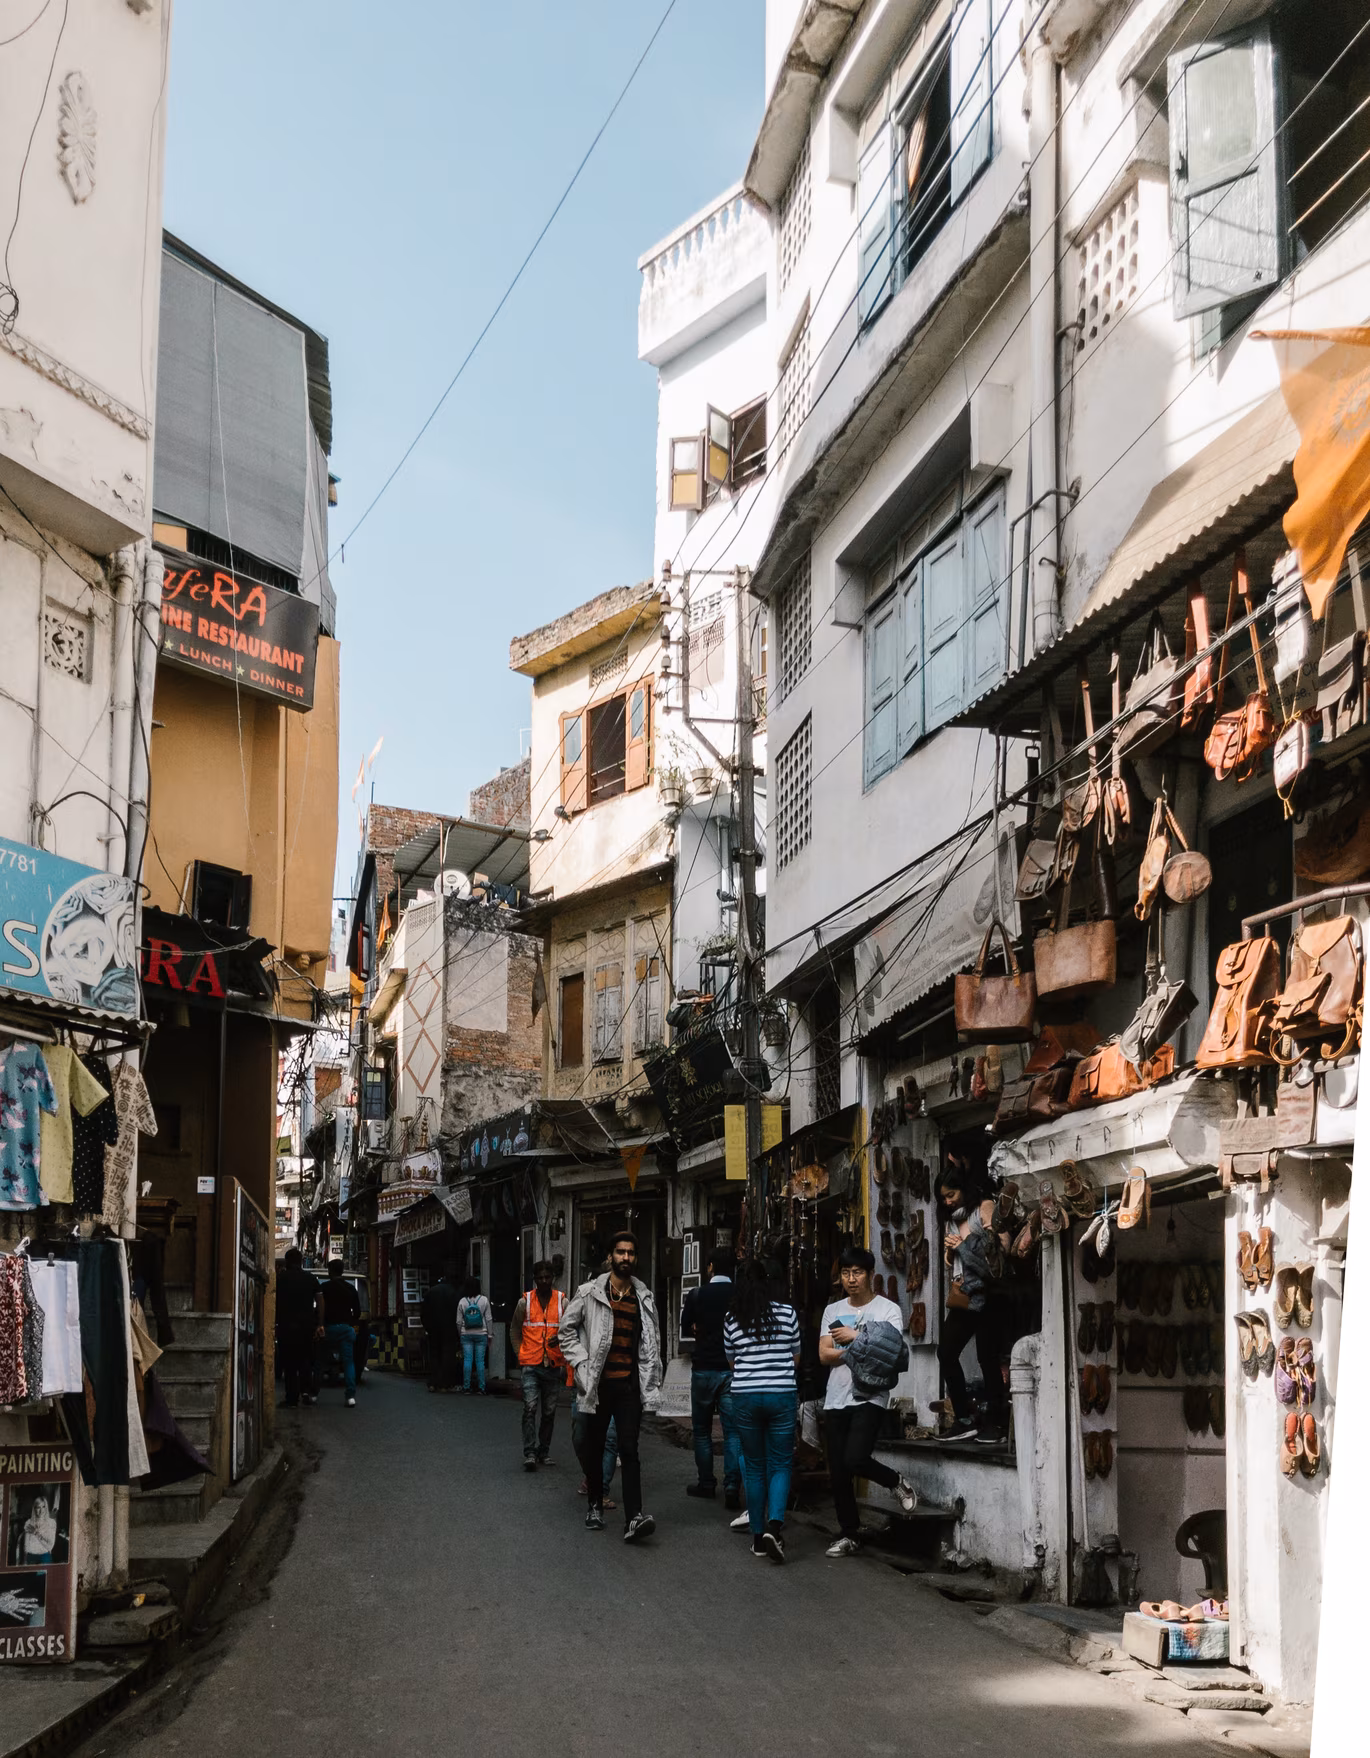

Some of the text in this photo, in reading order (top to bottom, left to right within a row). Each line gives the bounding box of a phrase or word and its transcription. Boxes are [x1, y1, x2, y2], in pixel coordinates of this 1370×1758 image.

[161, 603, 305, 673] INE RESTAURANT
[180, 643, 305, 698] LUNCH DINNER
[0, 1452, 72, 1474] PAINTING
[0, 1634, 65, 1659] CLASSES
